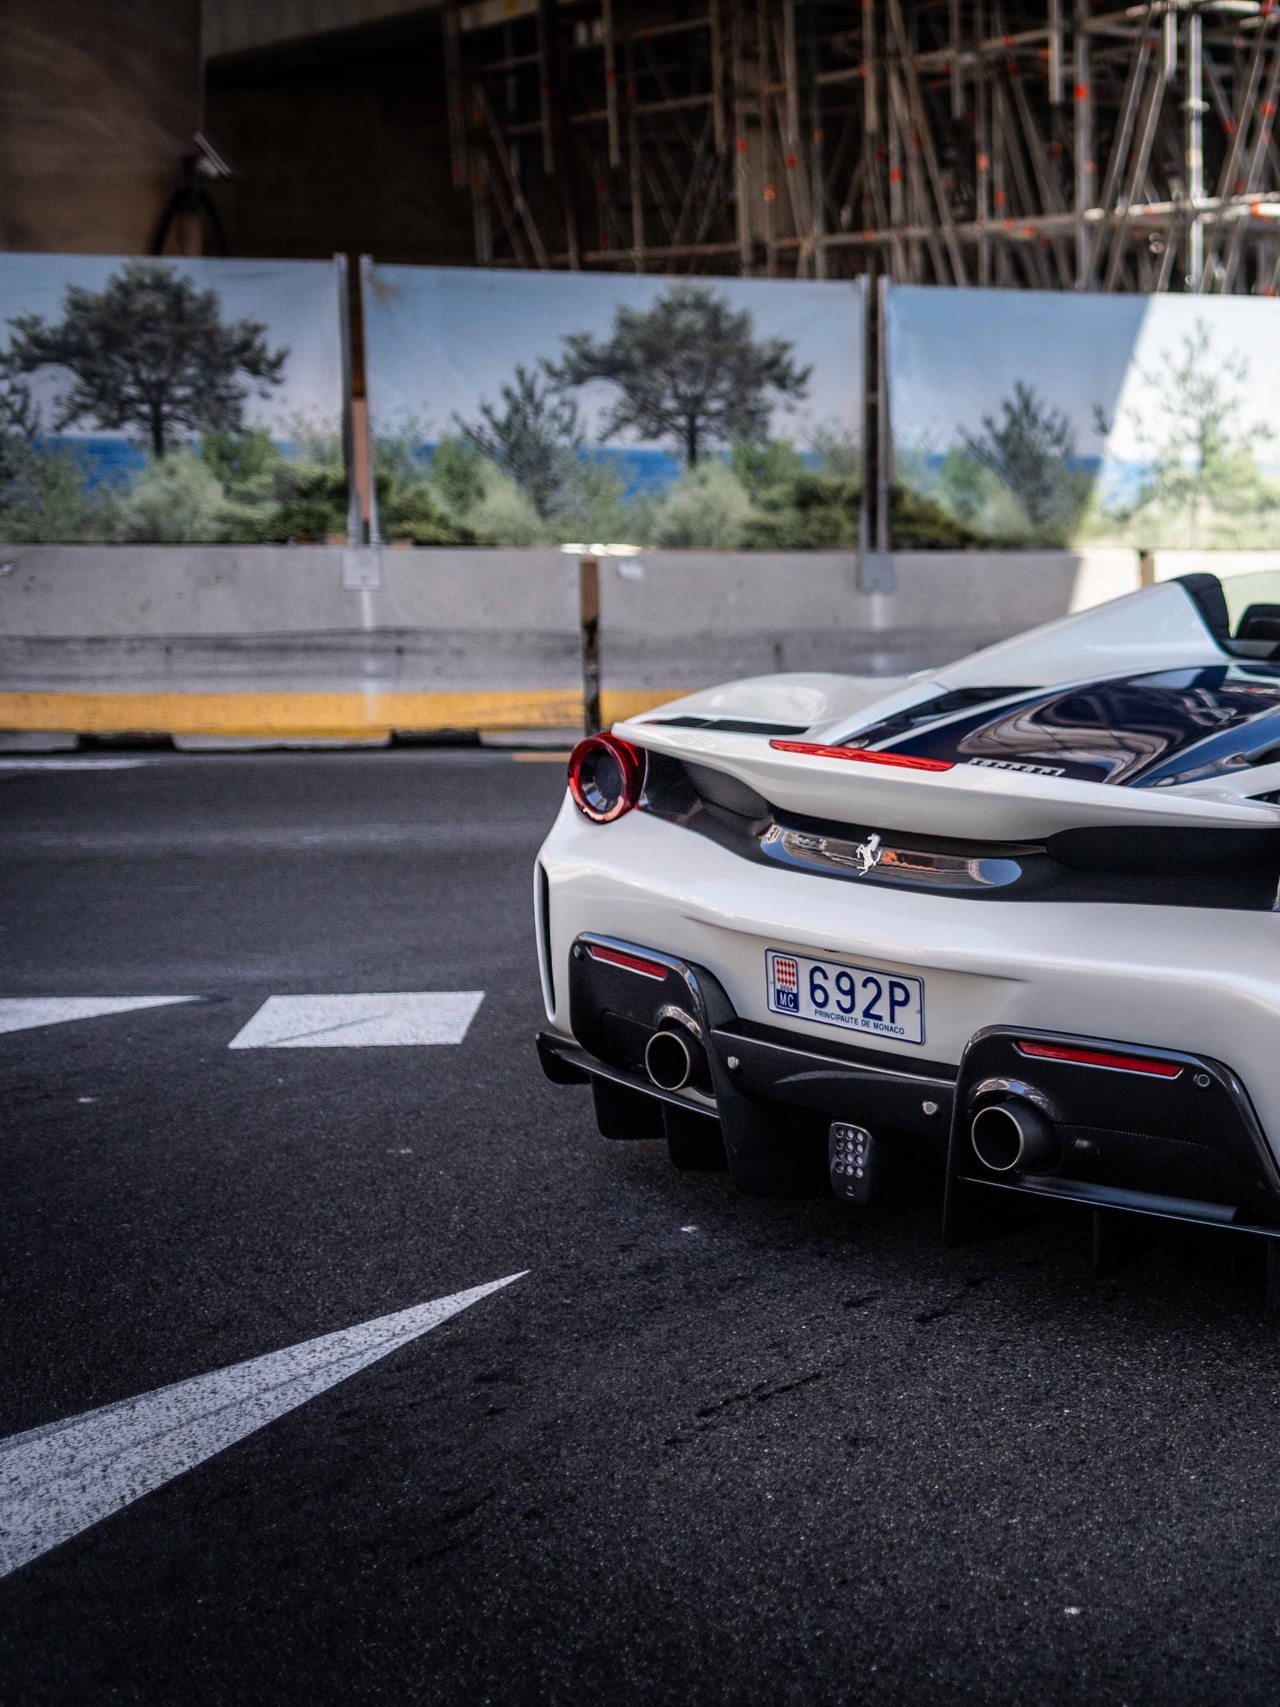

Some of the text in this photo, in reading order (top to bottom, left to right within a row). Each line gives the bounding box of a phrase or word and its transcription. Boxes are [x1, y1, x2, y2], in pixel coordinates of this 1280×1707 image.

[779, 992, 794, 1008] MC
[809, 965, 911, 1024] 692P
[814, 1008, 905, 1035] PRINCIPAUTE DE MONACO
